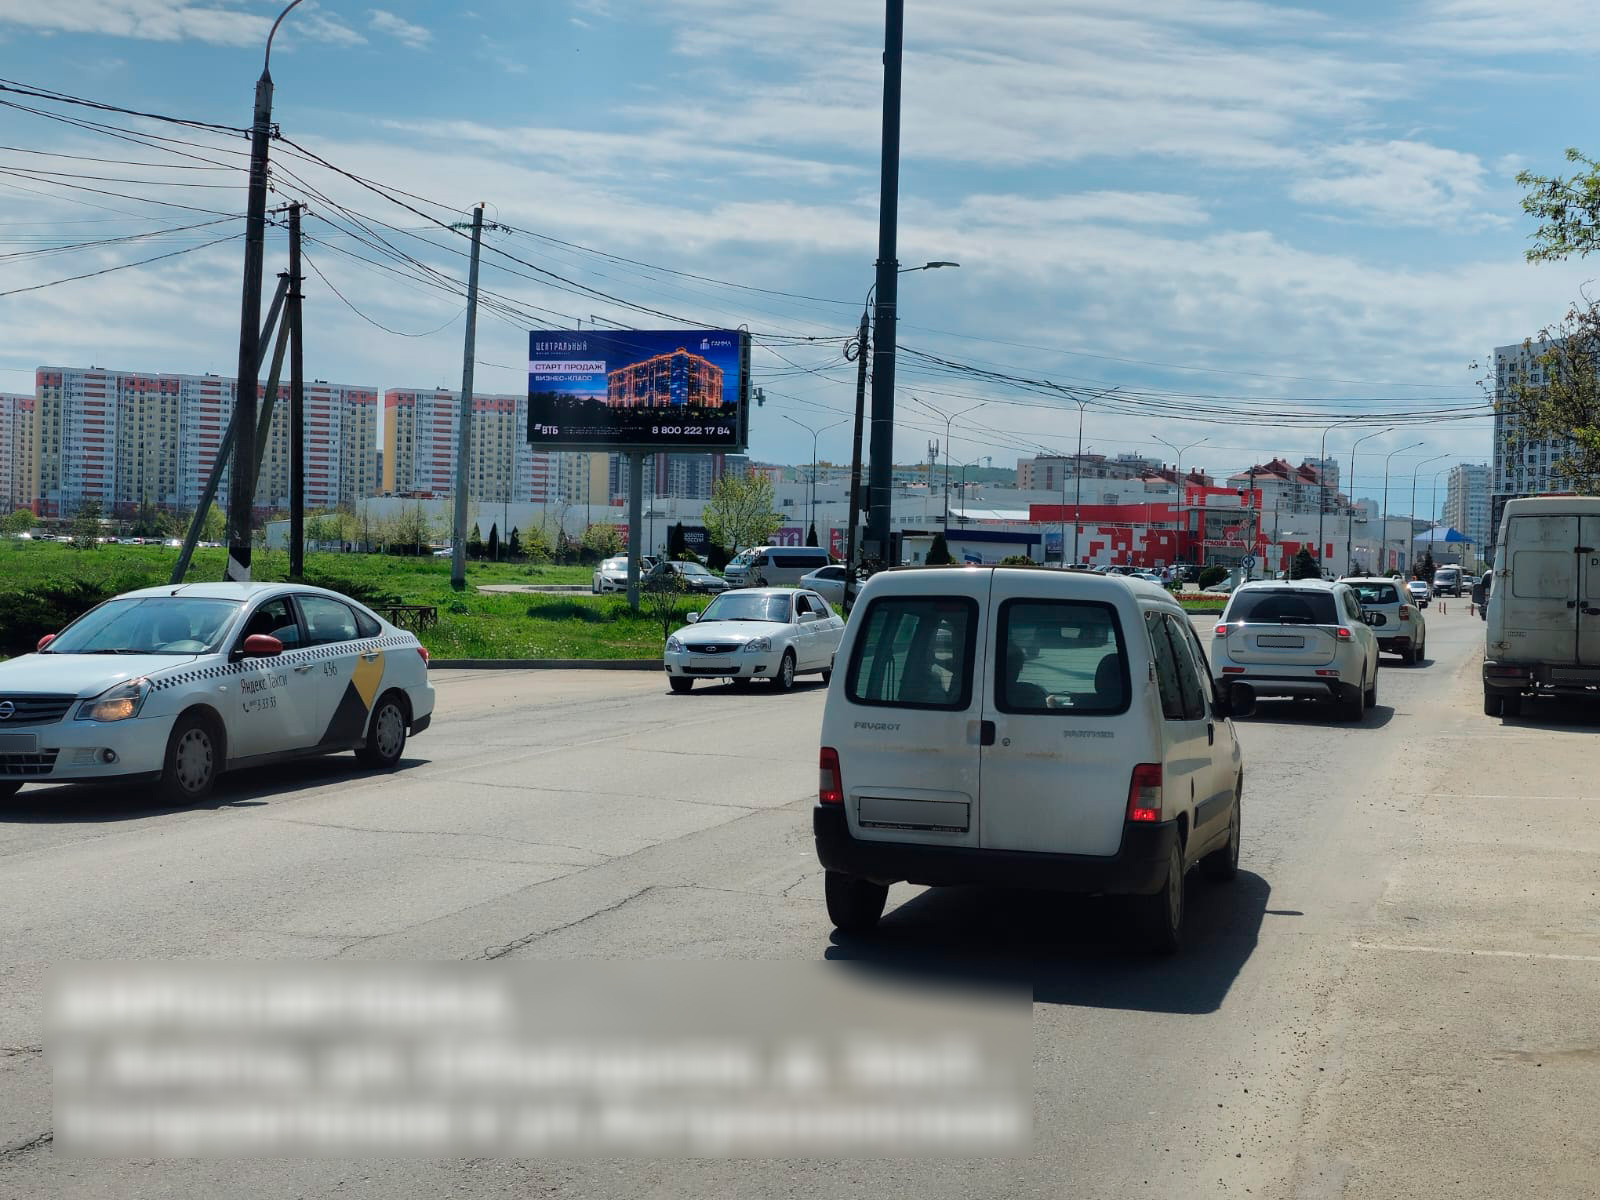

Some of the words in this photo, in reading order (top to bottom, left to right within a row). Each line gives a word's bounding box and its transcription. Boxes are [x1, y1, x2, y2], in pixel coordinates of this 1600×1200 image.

[535, 340, 588, 351] ЦЕНТРАЛЬНЫЙ
[535, 363, 561, 371] СТАРТ
[564, 363, 603, 371] ПРОДАЖ
[542, 426, 559, 435] ВТБ
[652, 426, 659, 434] 8
[661, 426, 681, 434] 800
[684, 426, 702, 435] 222
[704, 426, 715, 435] 17
[717, 427, 730, 435] 84
[324, 661, 338, 677] 436
[240, 678, 267, 694] Яндекс
[267, 673, 288, 689] Такси
[854, 721, 902, 731] PEUGEOT
